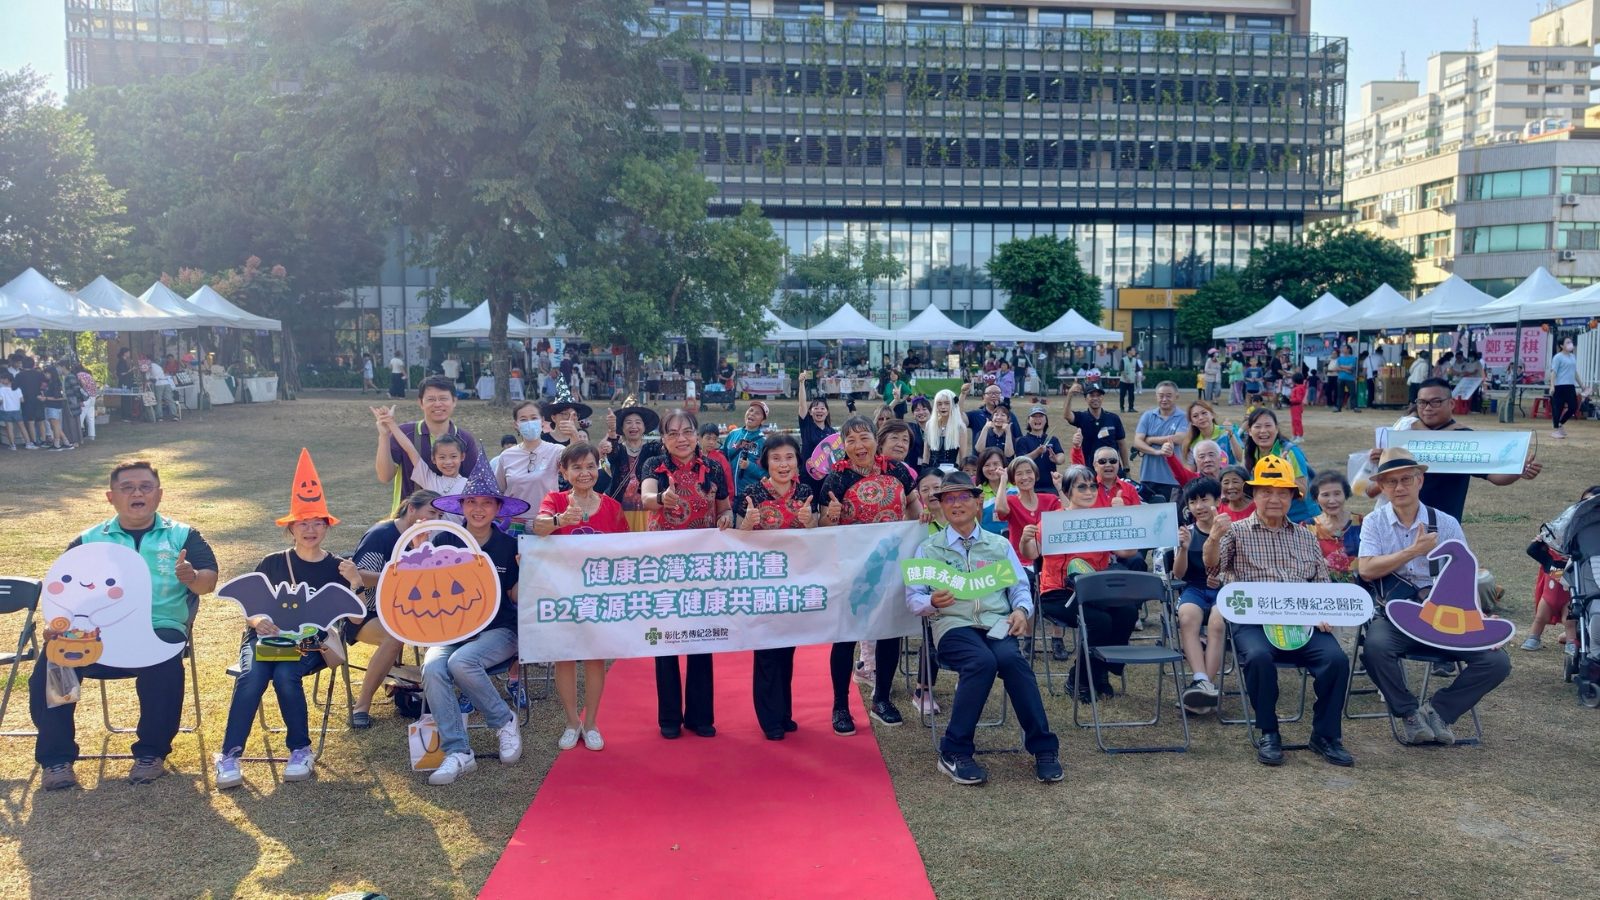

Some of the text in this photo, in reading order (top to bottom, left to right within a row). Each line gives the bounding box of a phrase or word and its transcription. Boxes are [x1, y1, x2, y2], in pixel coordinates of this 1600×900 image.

[583, 551, 787, 586] 健康台灣深耕計畫
[906, 565, 966, 592] 健康永續
[969, 574, 996, 590] ING
[538, 585, 826, 622] B2資源共享健康共融計畫
[1258, 597, 1363, 611] 彰化秀傳紀念醫院
[665, 628, 728, 639] 彰化秀傳紀念醫院
